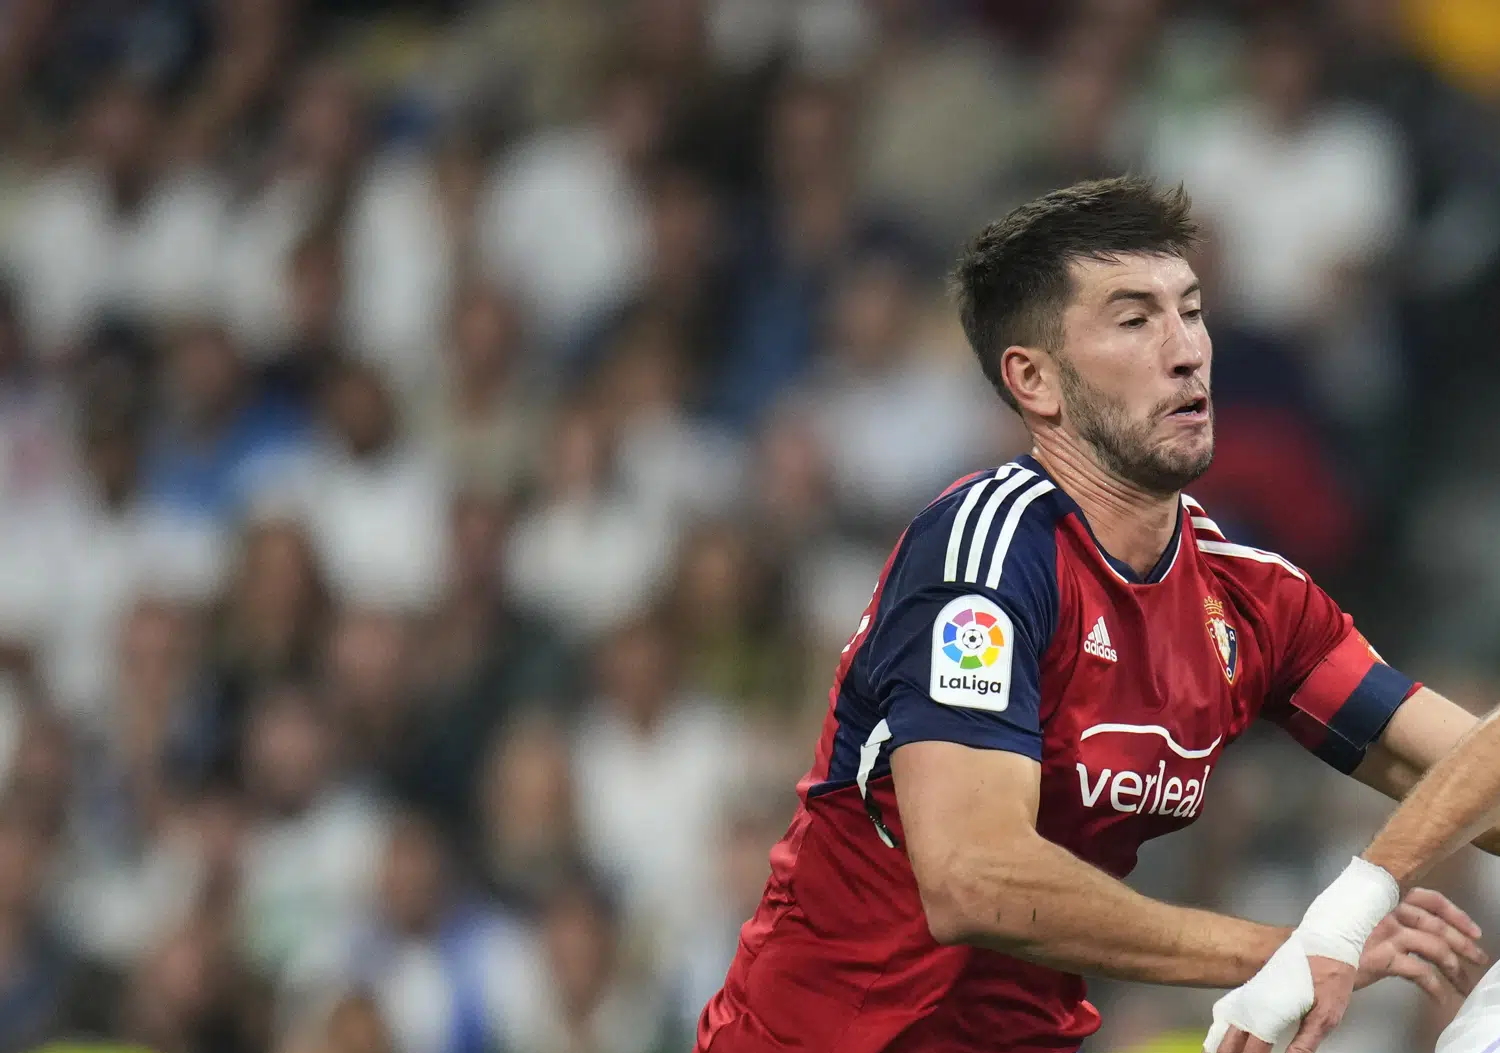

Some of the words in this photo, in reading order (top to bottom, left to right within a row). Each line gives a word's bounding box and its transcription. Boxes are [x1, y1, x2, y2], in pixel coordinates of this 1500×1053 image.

[1083, 639, 1118, 663] adidas
[940, 674, 1002, 695] LaLiga
[1076, 759, 1211, 818] verleal
